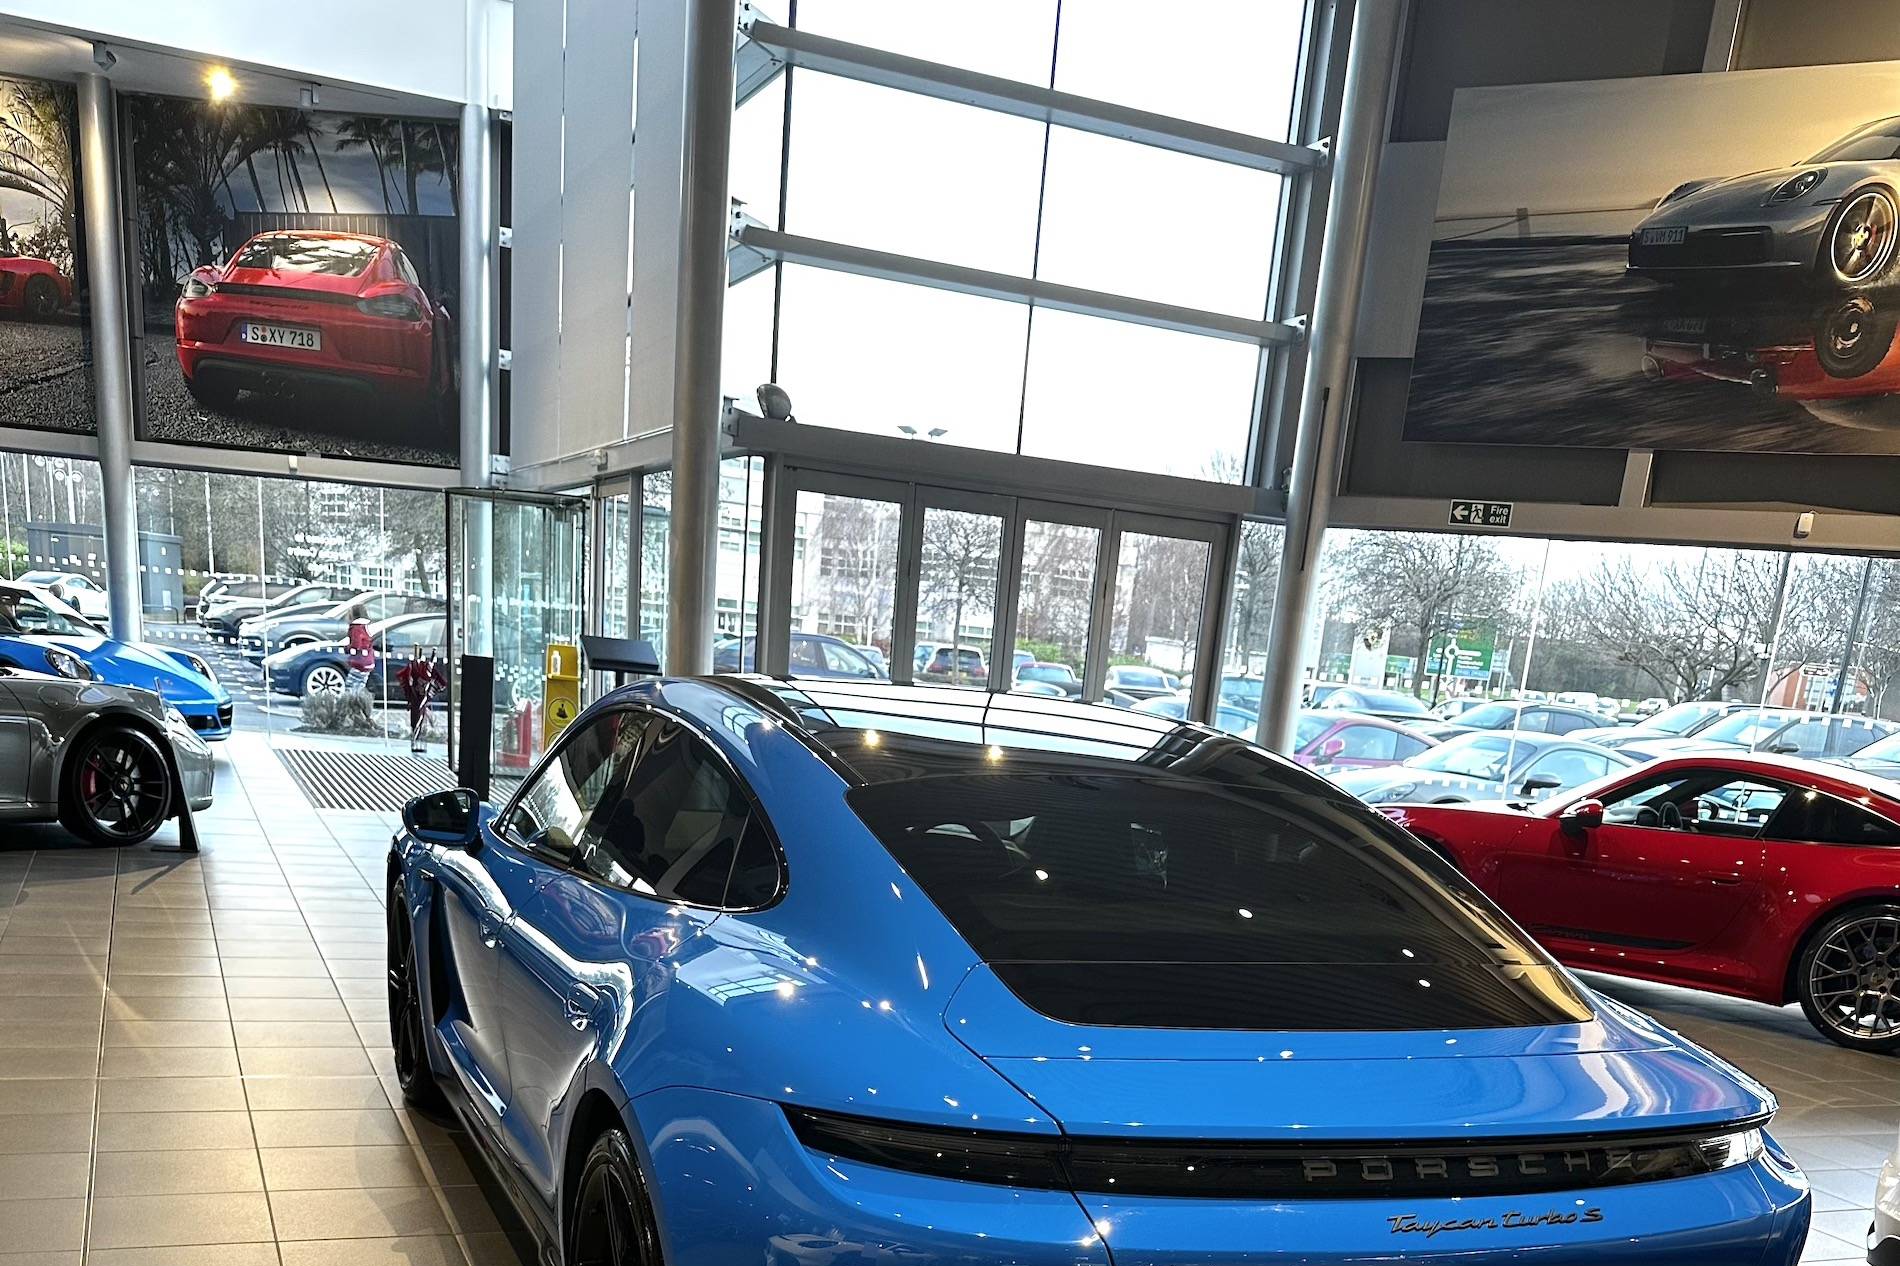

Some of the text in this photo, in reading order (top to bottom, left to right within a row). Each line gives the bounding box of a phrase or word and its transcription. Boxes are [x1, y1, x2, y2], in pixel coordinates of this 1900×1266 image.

[251, 326, 314, 347] S XY 718
[1489, 515, 1507, 524] exit
[1490, 505, 1509, 516] Fire
[1302, 1149, 1633, 1182] PORSCHE
[1386, 1212, 1499, 1239] Taycan
[1579, 1207, 1604, 1224] S
